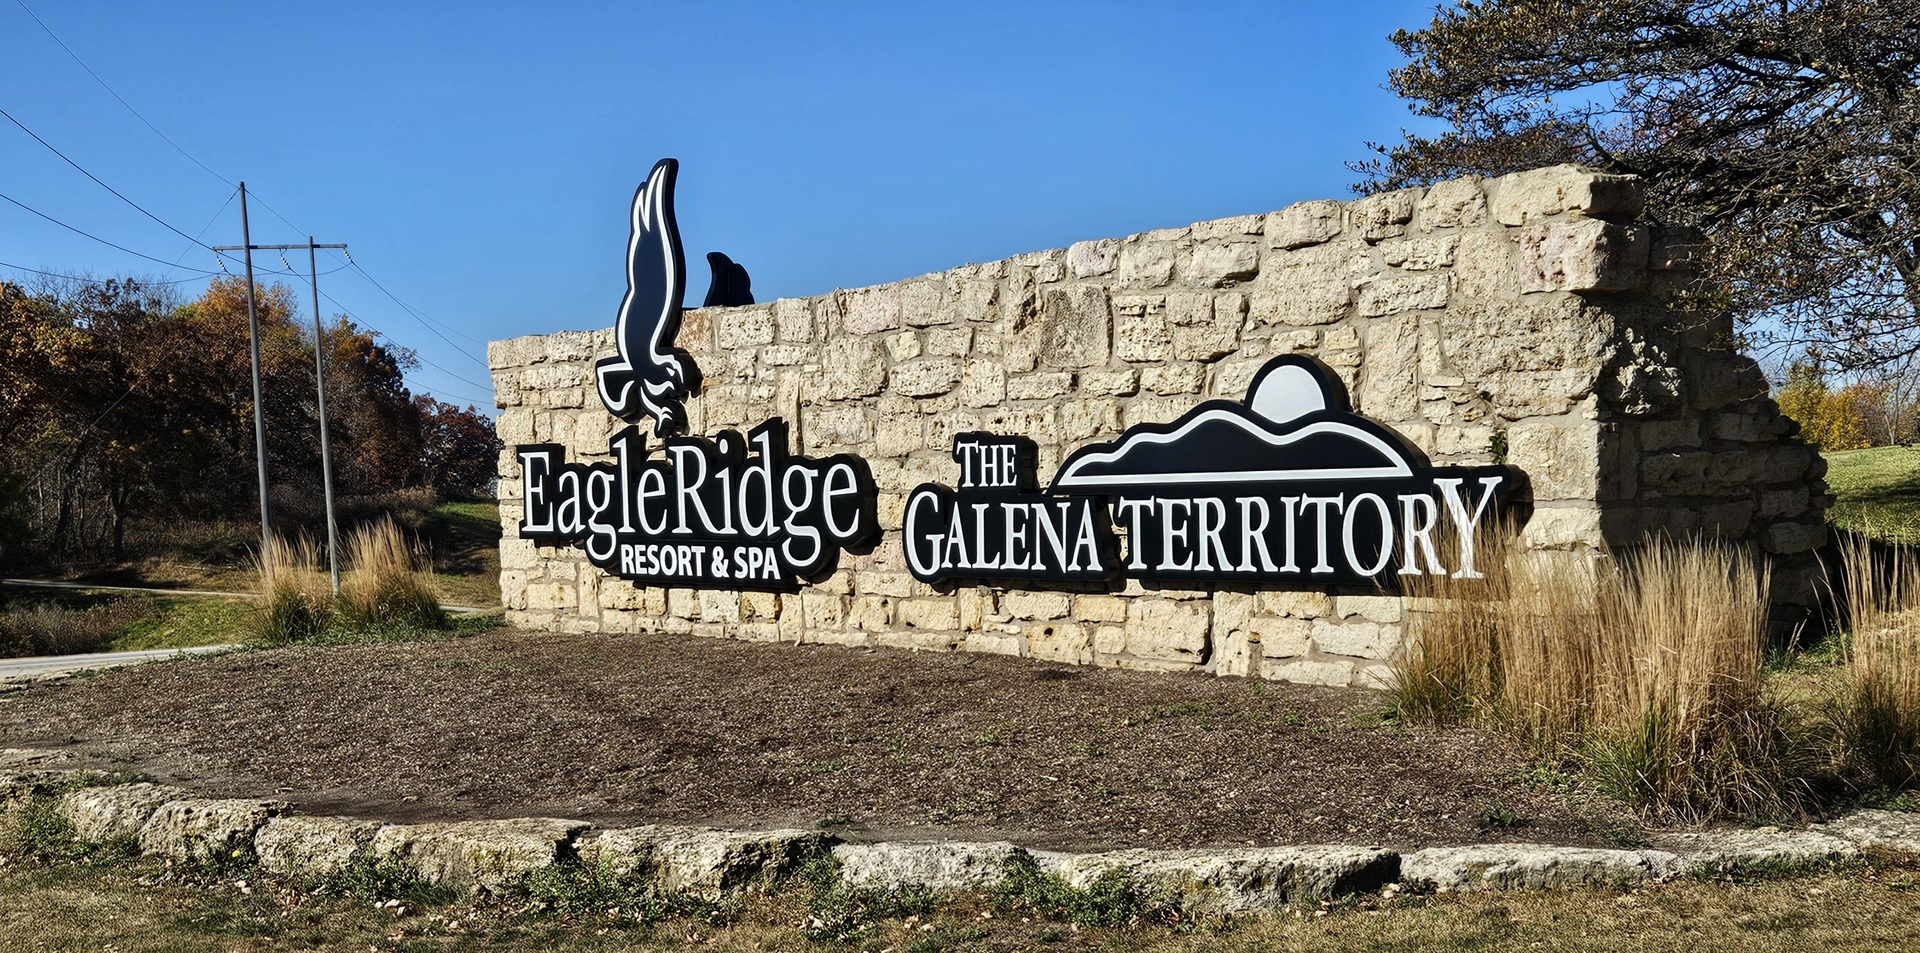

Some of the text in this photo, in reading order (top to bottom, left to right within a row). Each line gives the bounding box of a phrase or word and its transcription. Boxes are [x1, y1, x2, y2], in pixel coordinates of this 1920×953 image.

[519, 430, 860, 567] EagleRidge
[956, 440, 1018, 488] THE
[620, 543, 781, 580] RESORT & SPA
[905, 476, 1503, 579] GALENA TERRITORY
